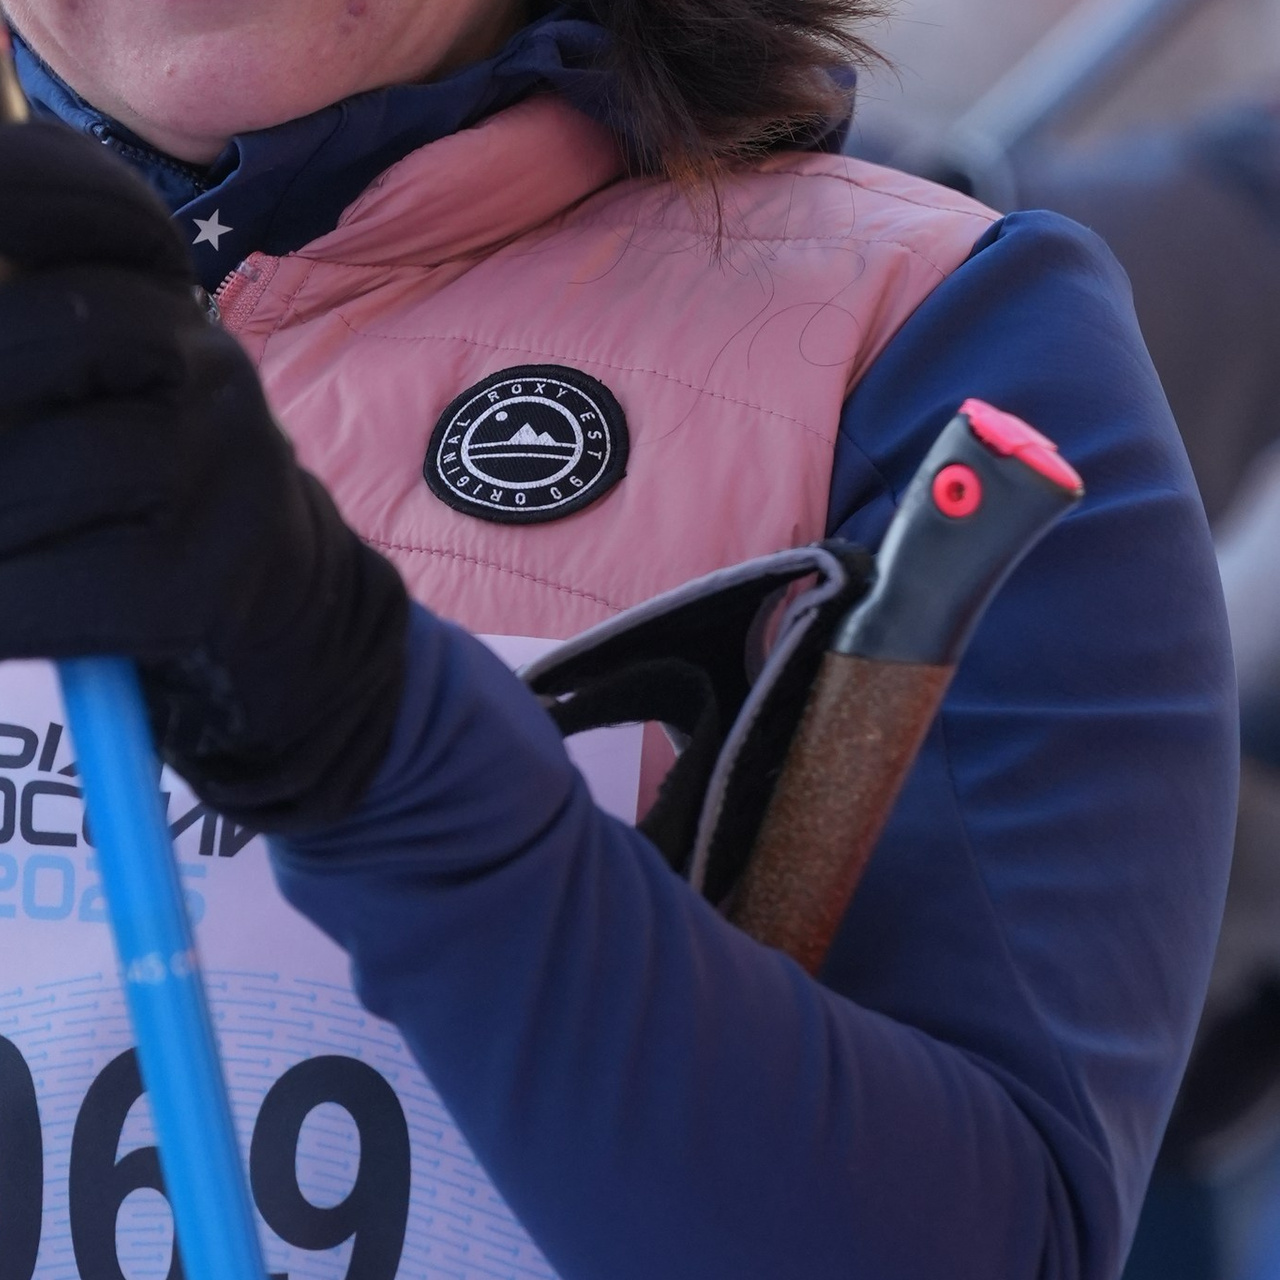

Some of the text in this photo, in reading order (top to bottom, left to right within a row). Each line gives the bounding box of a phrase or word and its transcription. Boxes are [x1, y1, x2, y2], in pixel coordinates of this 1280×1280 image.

[442, 382, 603, 505] ORIGINAL ROXY EST 90
